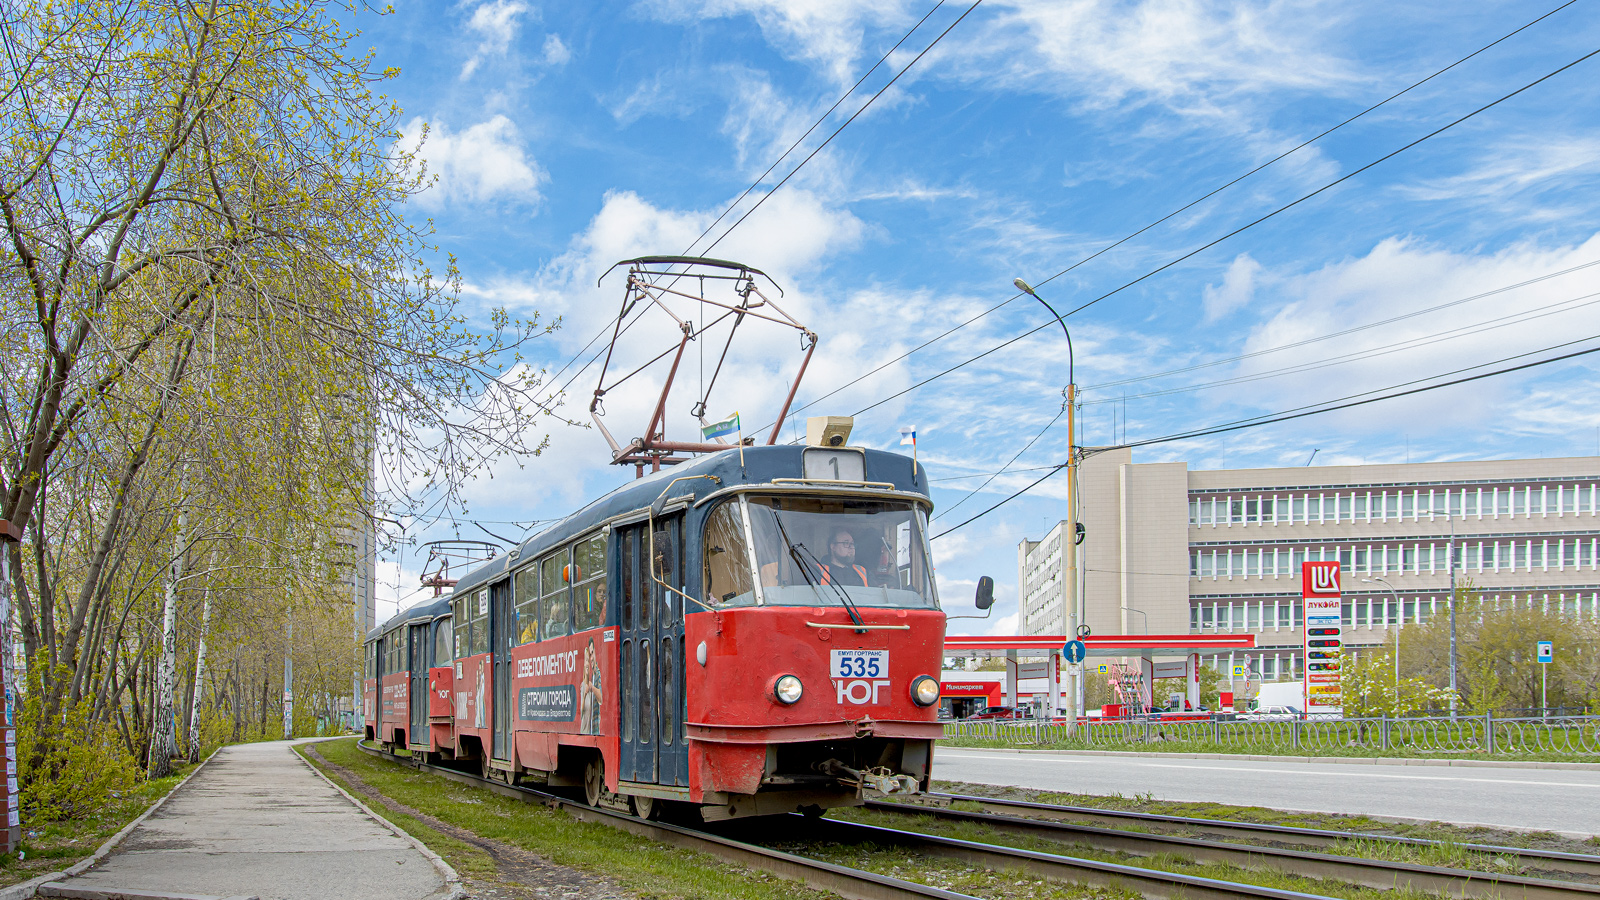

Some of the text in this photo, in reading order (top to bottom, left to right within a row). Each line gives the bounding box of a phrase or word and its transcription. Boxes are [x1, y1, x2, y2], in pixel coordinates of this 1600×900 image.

[828, 456, 840, 480] 1
[1308, 600, 1339, 608] ЛУКОЙЛ
[840, 657, 880, 677] 535
[527, 691, 548, 706] СТРОИМ
[548, 689, 572, 708] ГОРОДА
